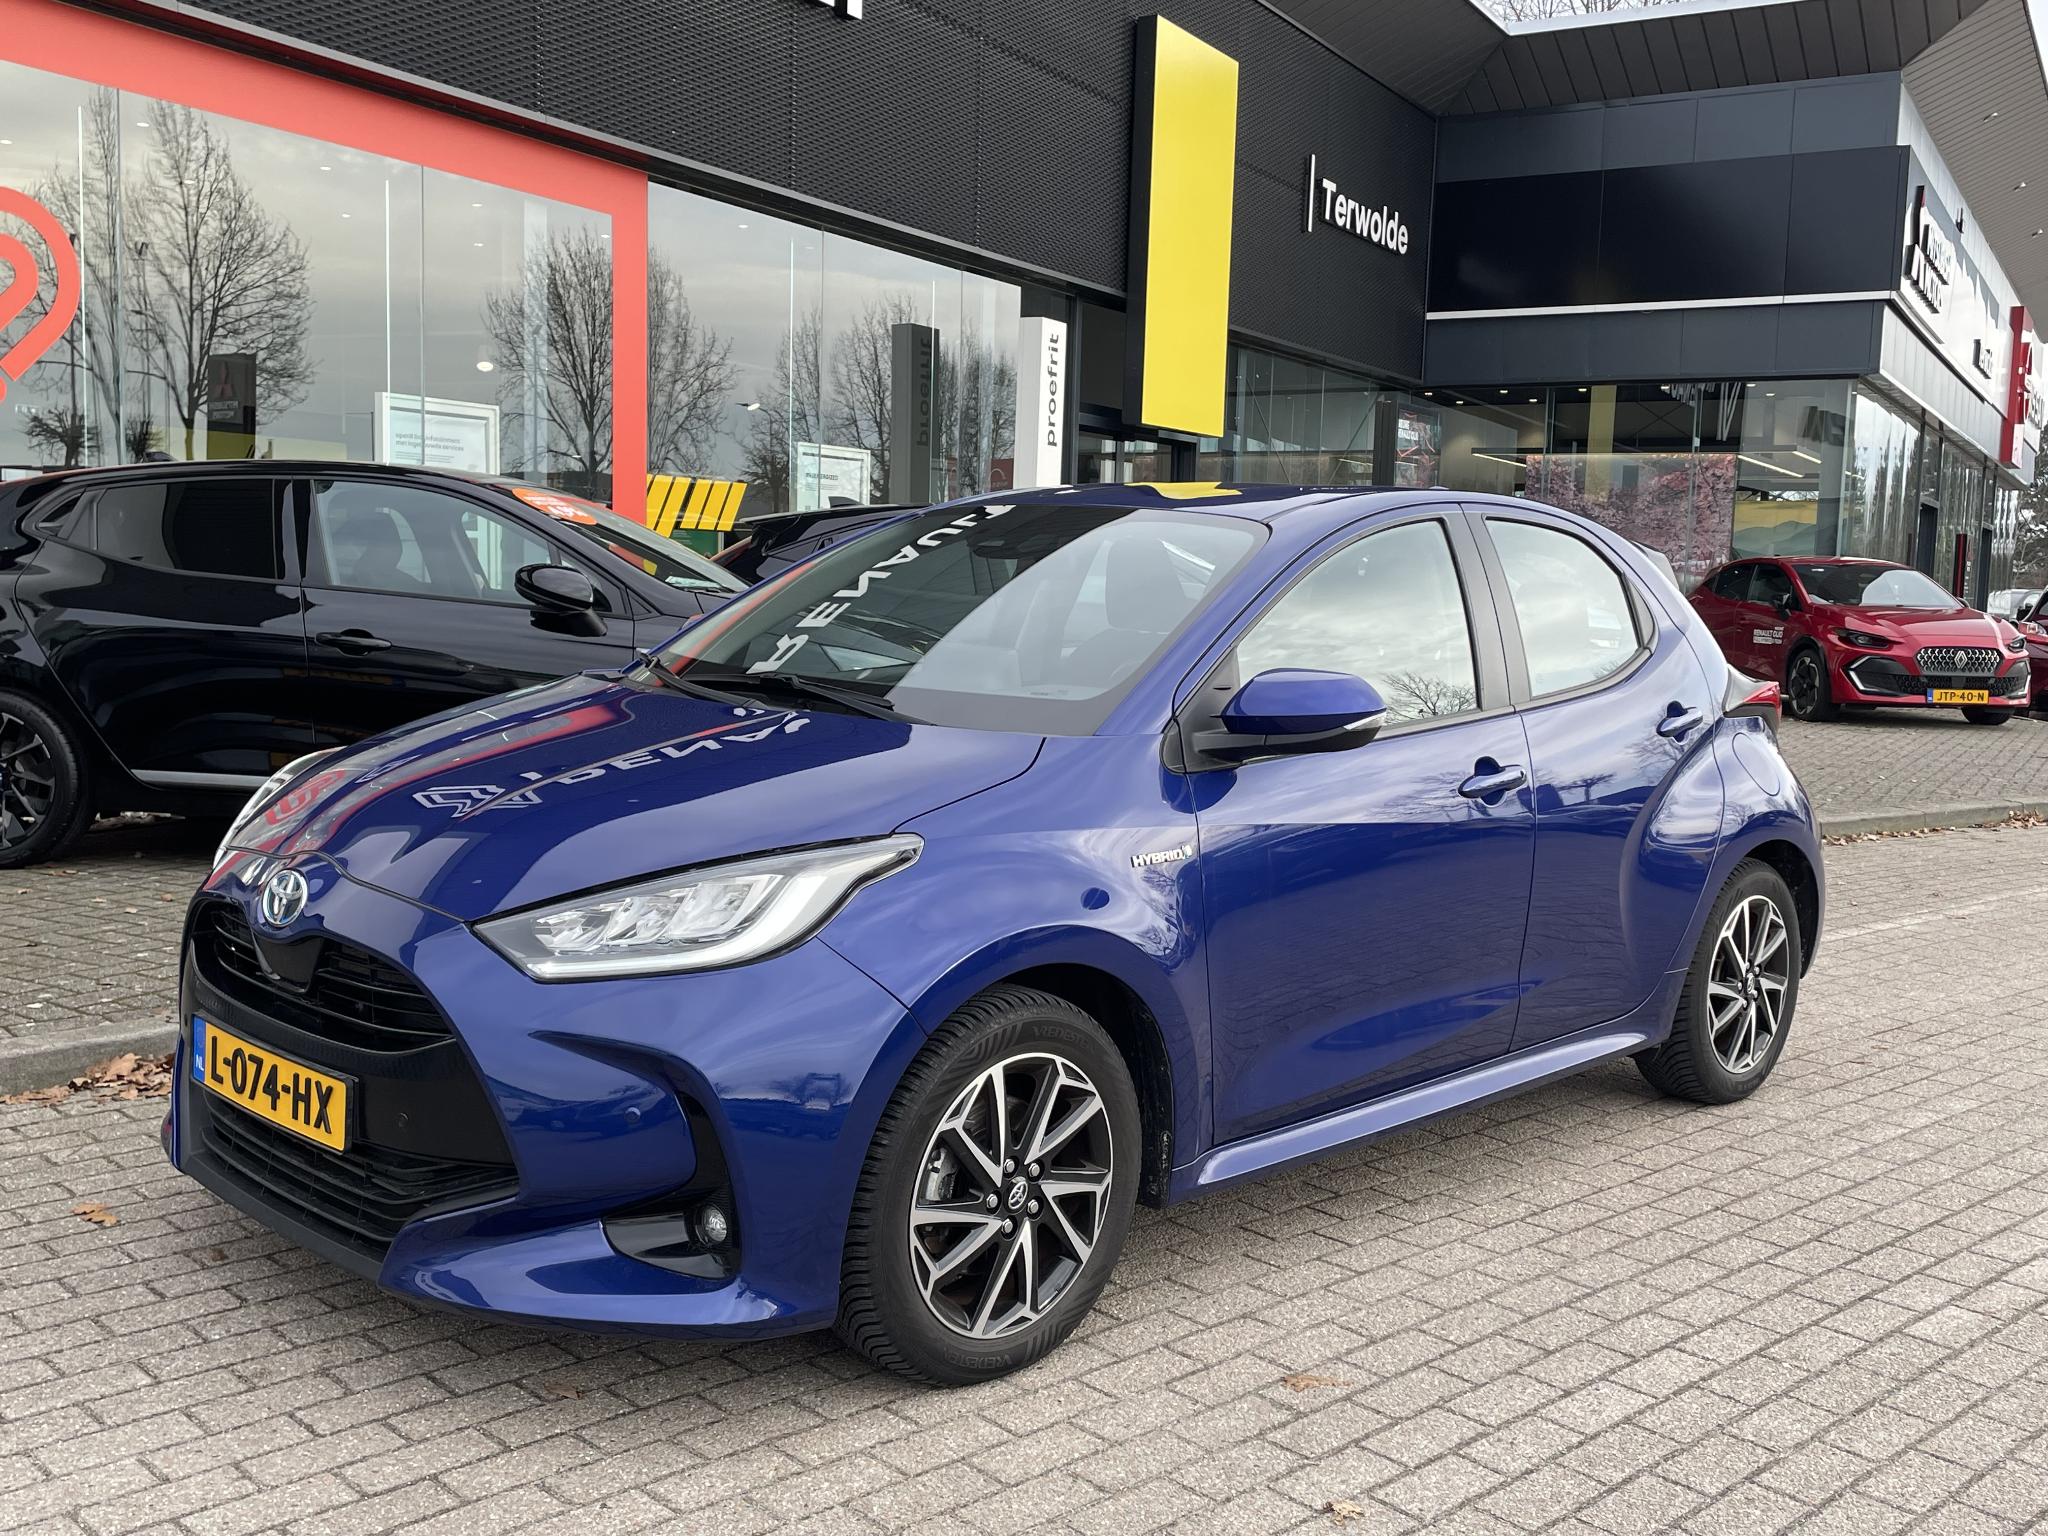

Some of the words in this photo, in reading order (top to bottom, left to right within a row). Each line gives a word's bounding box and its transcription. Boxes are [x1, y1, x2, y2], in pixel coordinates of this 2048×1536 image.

[1322, 177, 1408, 254] Terwolde
[1047, 333, 1059, 447] proefrit
[1937, 691, 1985, 702] JTP-40-N
[1131, 849, 1183, 868] HYBRID
[195, 1054, 204, 1071] NL
[210, 1035, 334, 1135] L-074-HX
